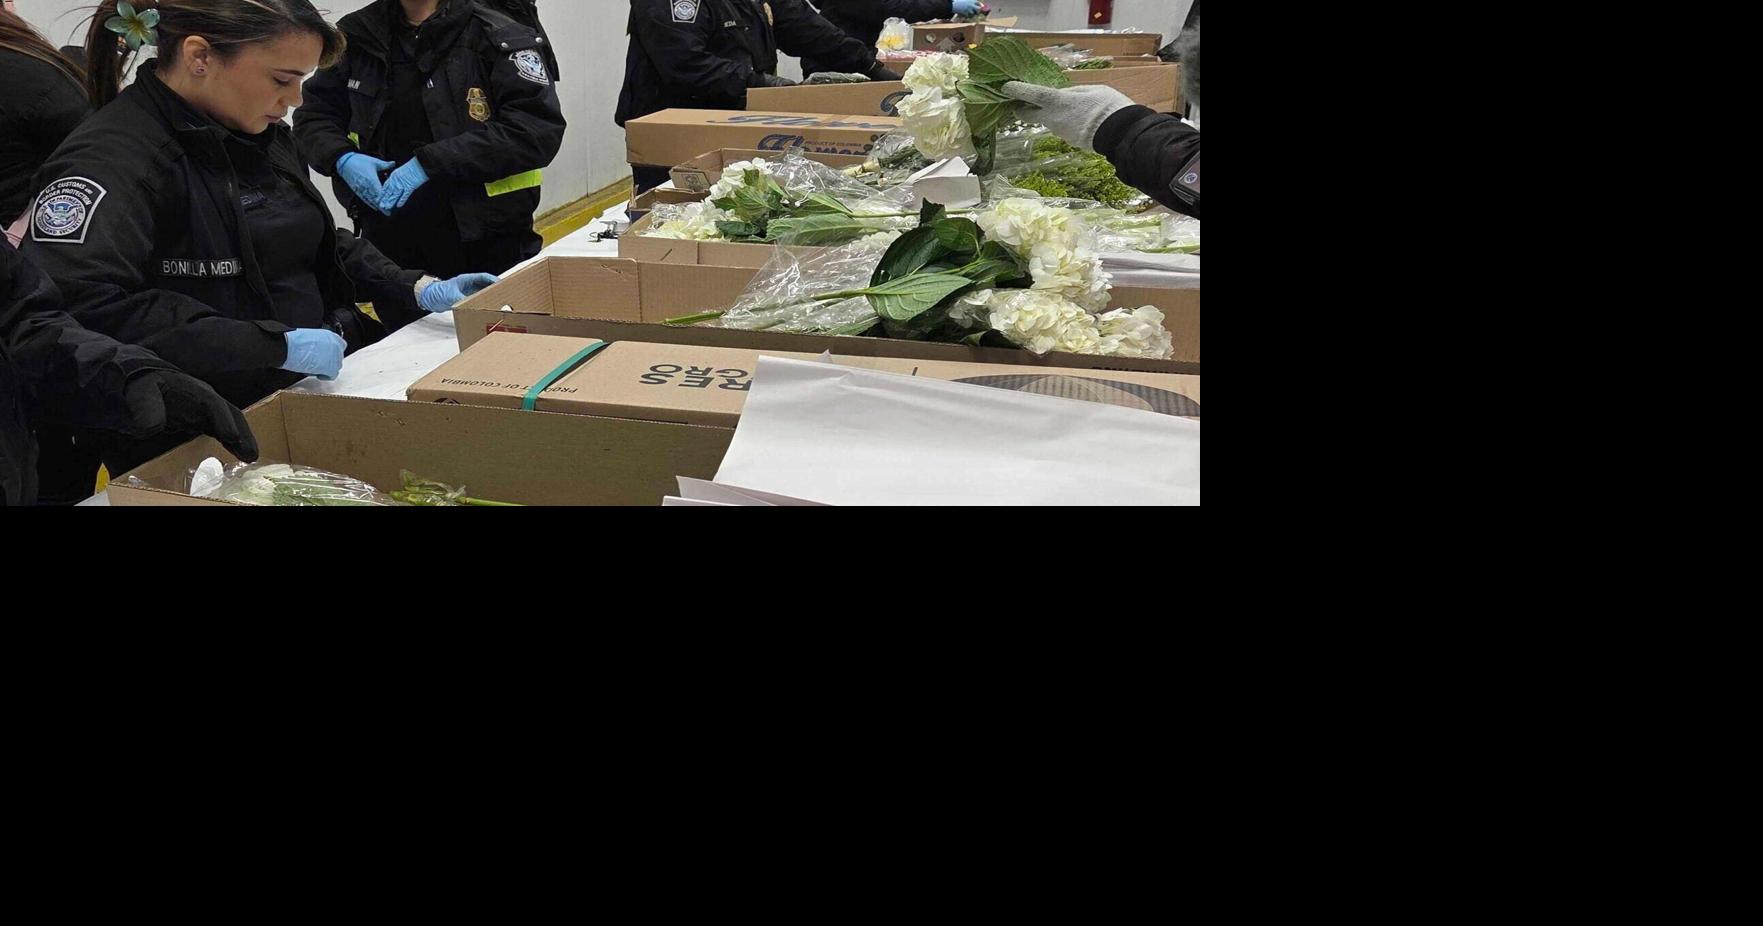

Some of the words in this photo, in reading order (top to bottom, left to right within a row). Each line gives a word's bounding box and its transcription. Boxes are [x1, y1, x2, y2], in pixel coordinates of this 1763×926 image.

[57, 181, 86, 190] CUSTOMS
[61, 188, 93, 206] PROTECTION
[441, 378, 501, 387] COLOMBIA
